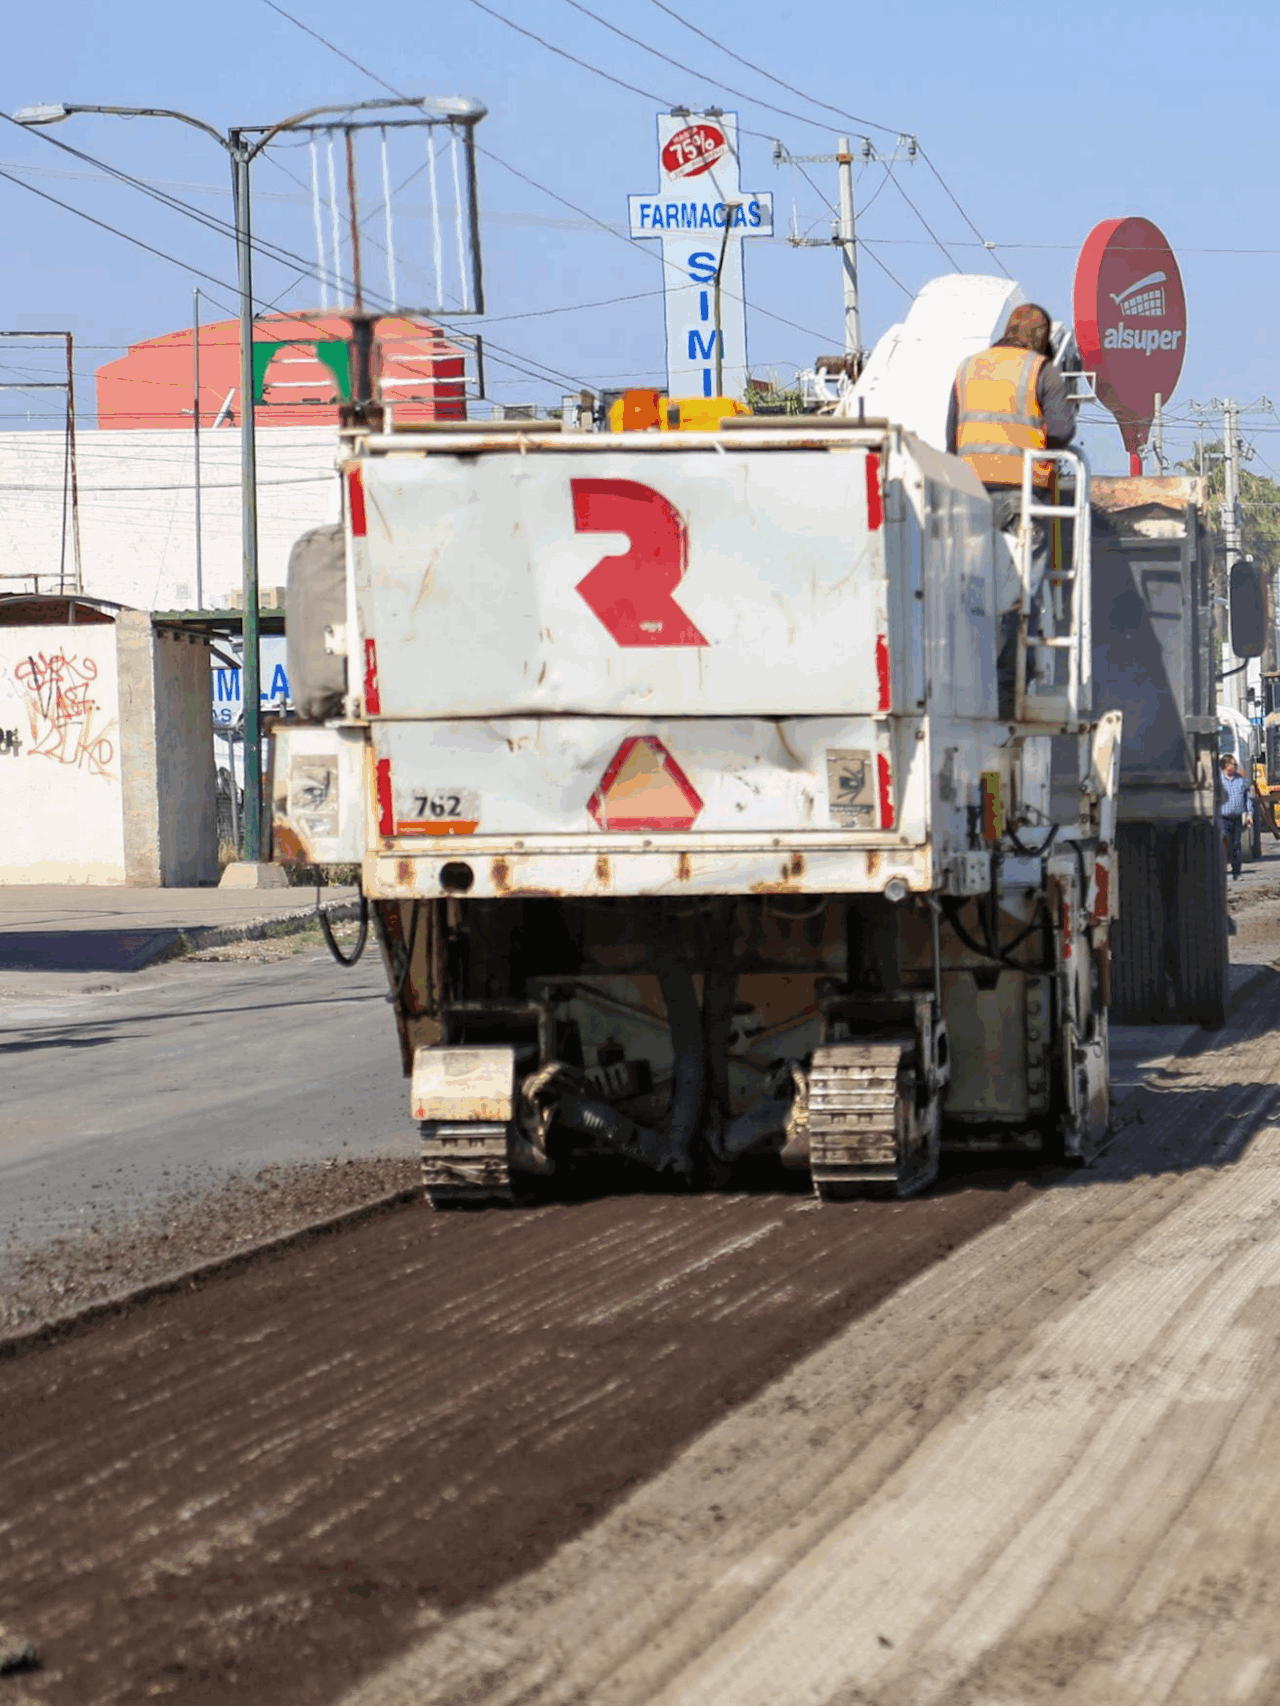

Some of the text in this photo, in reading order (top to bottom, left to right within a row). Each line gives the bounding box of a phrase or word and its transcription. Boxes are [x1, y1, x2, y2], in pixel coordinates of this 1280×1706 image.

[669, 130, 716, 165] 75%
[639, 201, 761, 229] FARMACAS
[687, 252, 725, 398] SIMI
[1103, 321, 1182, 356] alsuper
[570, 478, 711, 647] R
[413, 795, 462, 817] 762
